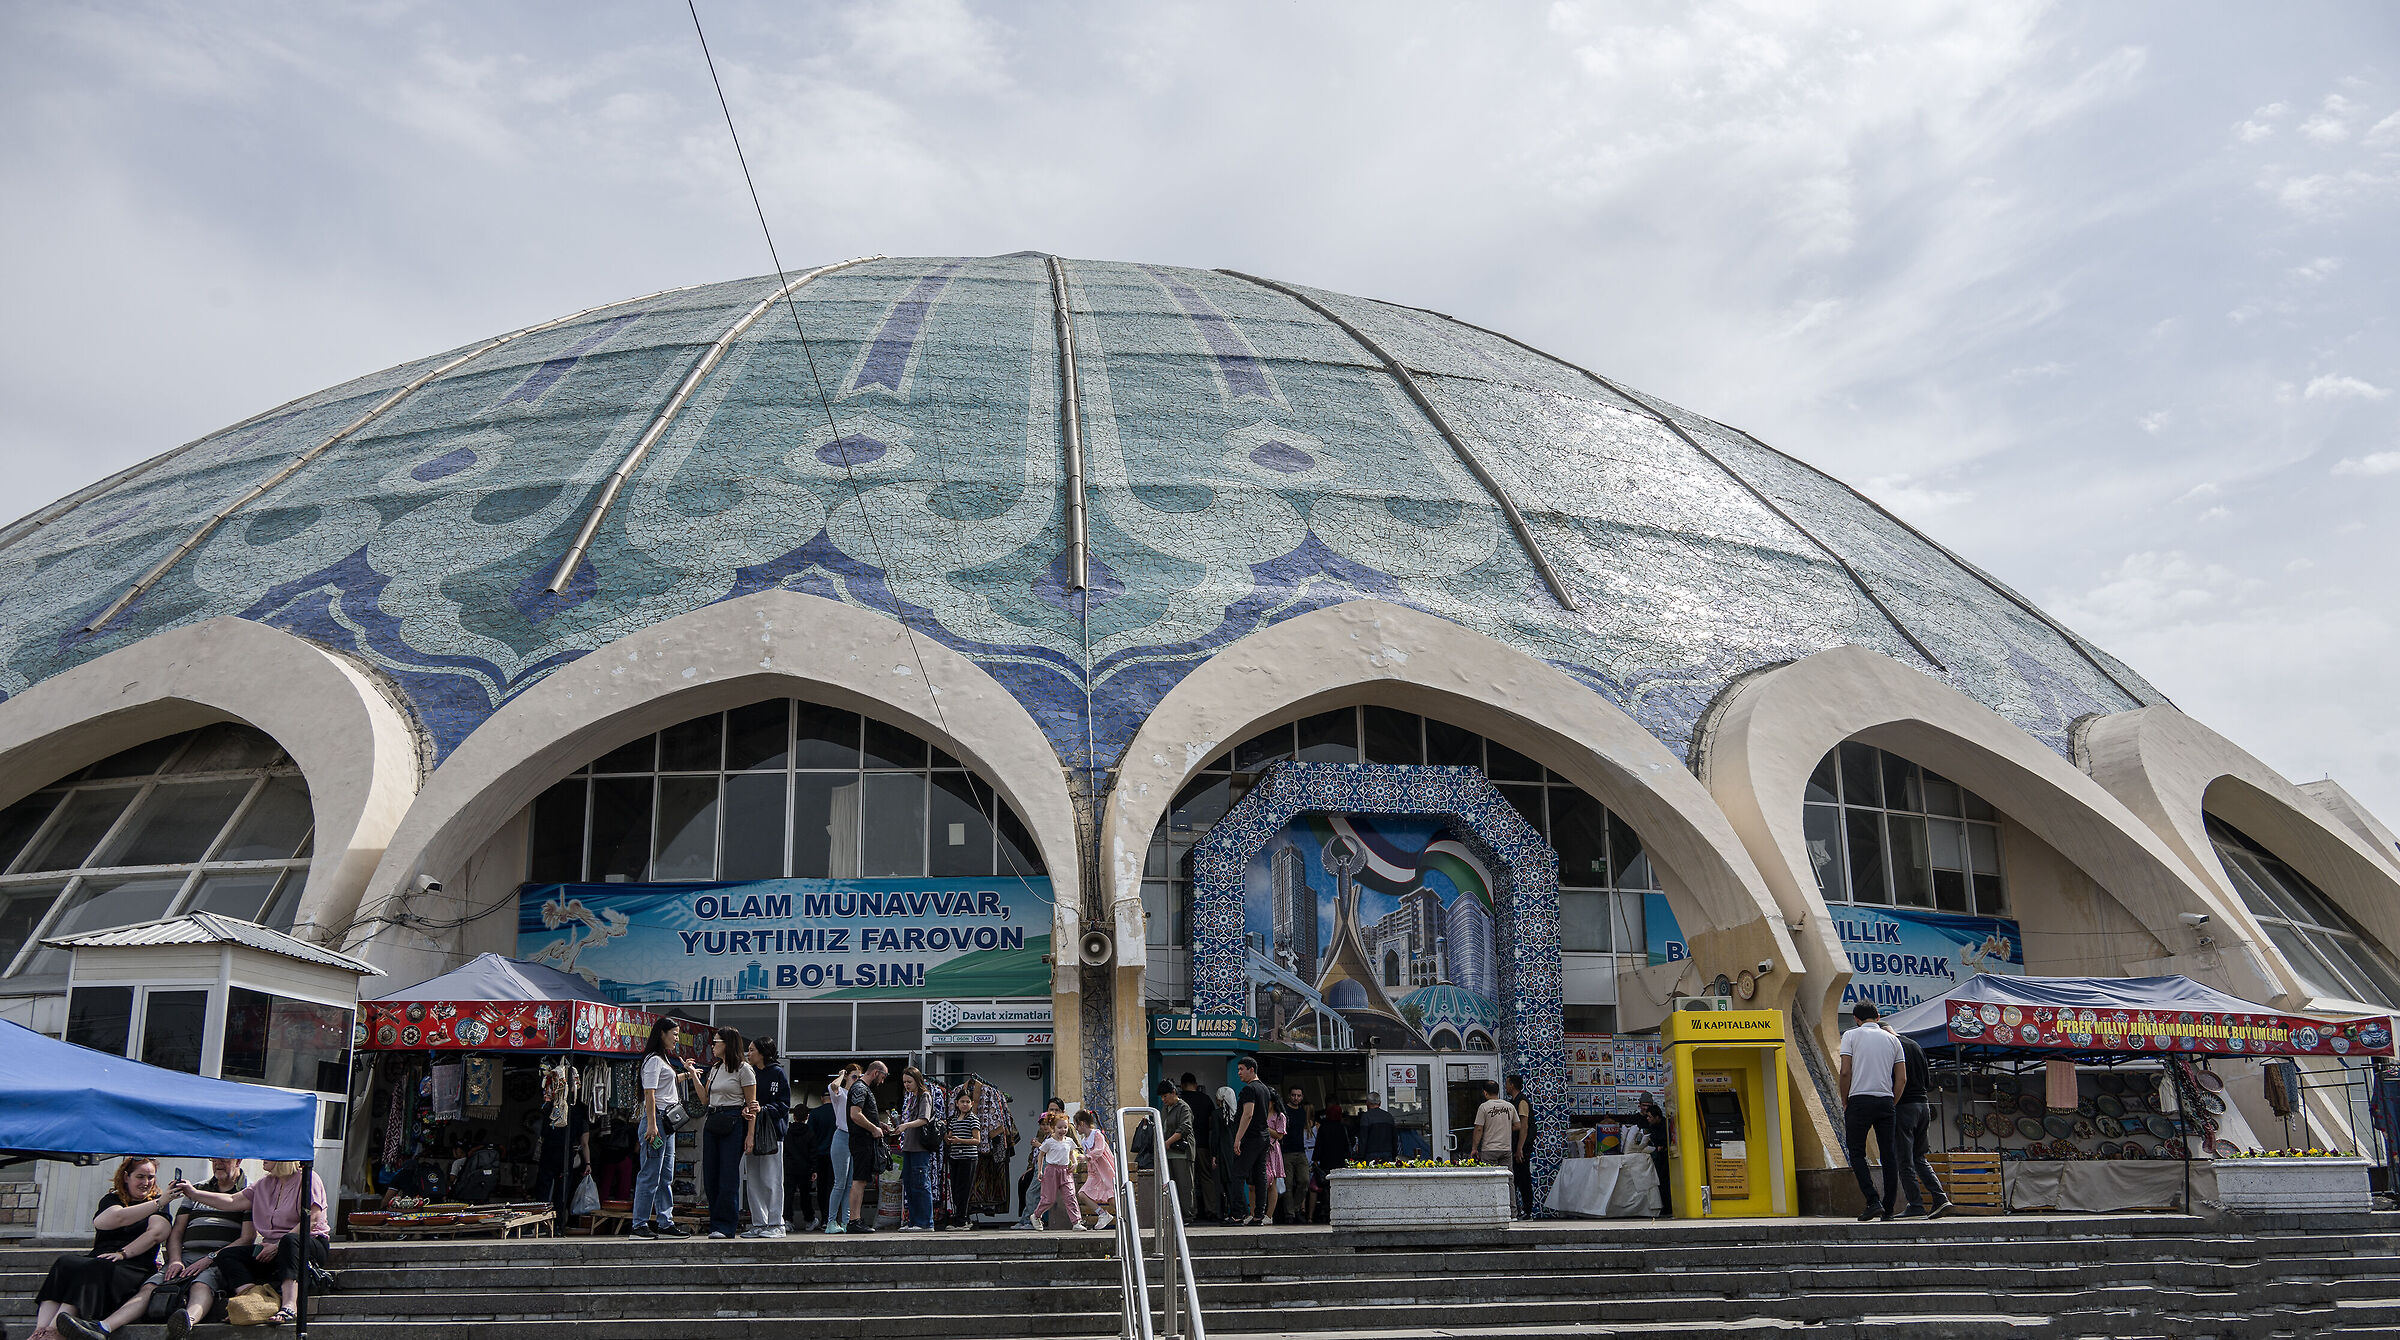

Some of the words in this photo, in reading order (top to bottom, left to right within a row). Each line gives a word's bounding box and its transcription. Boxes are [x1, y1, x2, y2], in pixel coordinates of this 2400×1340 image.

[694, 894, 793, 920] OLAM
[804, 890, 1011, 920] MUNAVVAR,
[679, 928, 850, 955] YURTIMIZ
[861, 925, 1025, 951] FAROVON
[1832, 919, 1902, 946] ILLIK
[1844, 951, 1956, 983] UBORAK,
[1843, 983, 1910, 1007] ANIM!
[962, 1010, 996, 1020] Davlat
[998, 1010, 1051, 1020] xizmatlari
[1704, 1020, 1771, 1030] KAPITALBANK
[1027, 1033, 1052, 1043] 24/7
[2095, 1021, 2129, 1036] MILLIY
[2130, 1022, 2230, 1039] HUNARMANDCHILIK
[2232, 1026, 2288, 1042] BUYUMLARI
